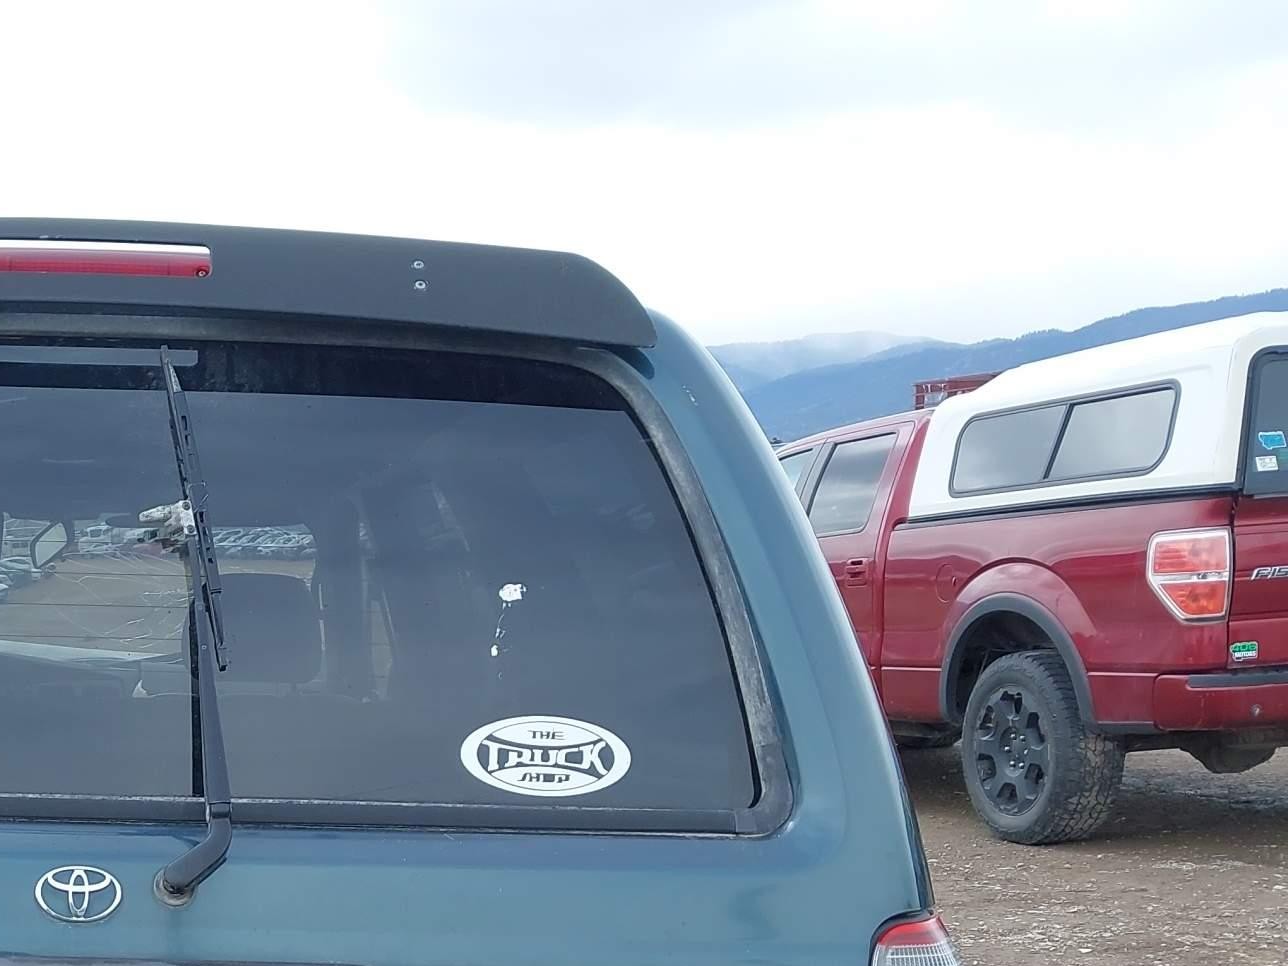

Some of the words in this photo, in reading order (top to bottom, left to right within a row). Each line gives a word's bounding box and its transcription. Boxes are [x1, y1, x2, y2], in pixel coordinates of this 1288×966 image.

[527, 730, 567, 741] THE
[481, 738, 609, 777] TRUCK
[516, 772, 571, 784] SHOP
